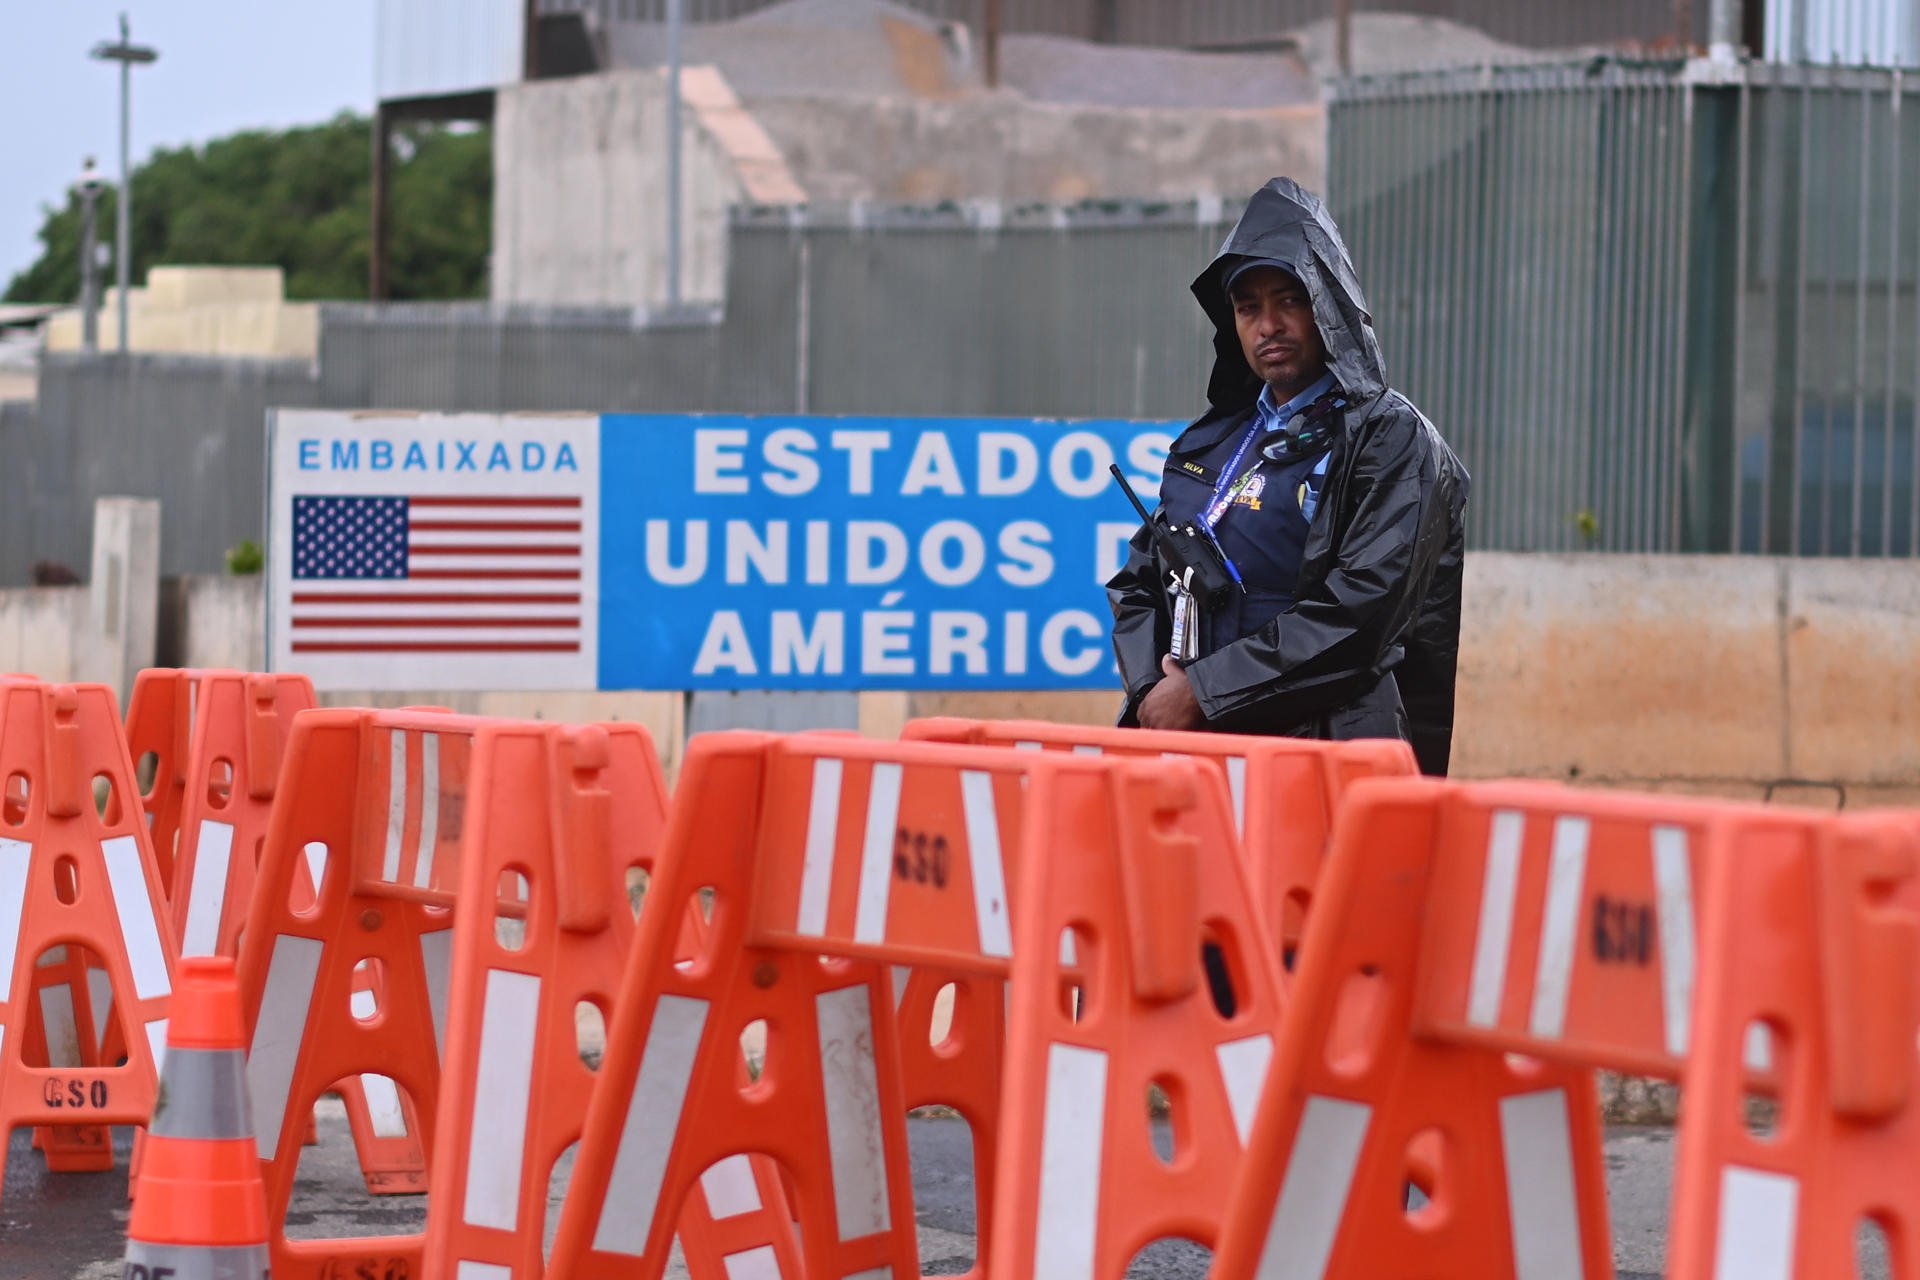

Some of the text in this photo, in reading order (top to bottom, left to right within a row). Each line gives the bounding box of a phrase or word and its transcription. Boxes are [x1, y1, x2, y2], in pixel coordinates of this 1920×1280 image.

[299, 440, 578, 472] EMBAIXADA
[694, 428, 1176, 497] ESTADOS
[1183, 462, 1204, 475] SILVA
[645, 519, 1055, 587] UNIDOS
[692, 591, 1120, 676] AMÉRIC
[43, 1077, 108, 1109] GSO
